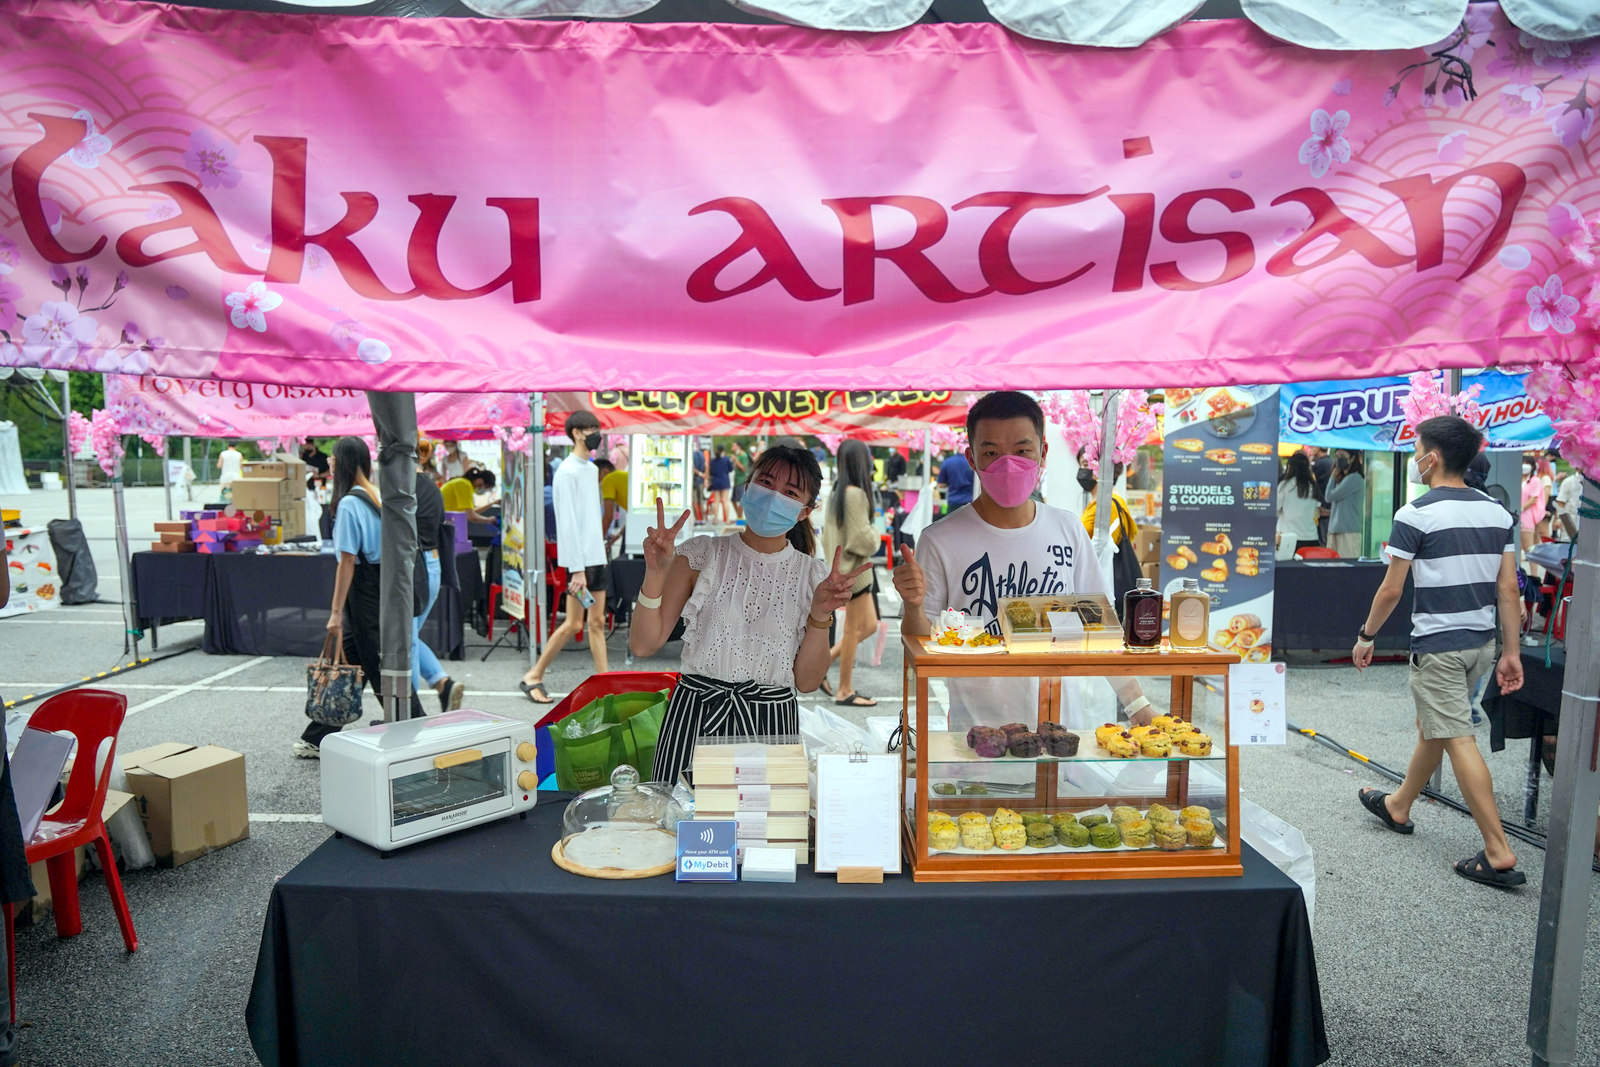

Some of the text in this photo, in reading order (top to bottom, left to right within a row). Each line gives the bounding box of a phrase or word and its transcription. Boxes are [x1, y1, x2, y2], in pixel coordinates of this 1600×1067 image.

[595, 390, 697, 411] BELLY
[709, 390, 832, 414] HONEY
[1492, 397, 1546, 423] HOU
[1169, 485, 1232, 495] STRUDELS
[1169, 495, 1178, 505] &
[1180, 495, 1235, 505] COOKIES
[694, 861, 729, 869] MyDebit
